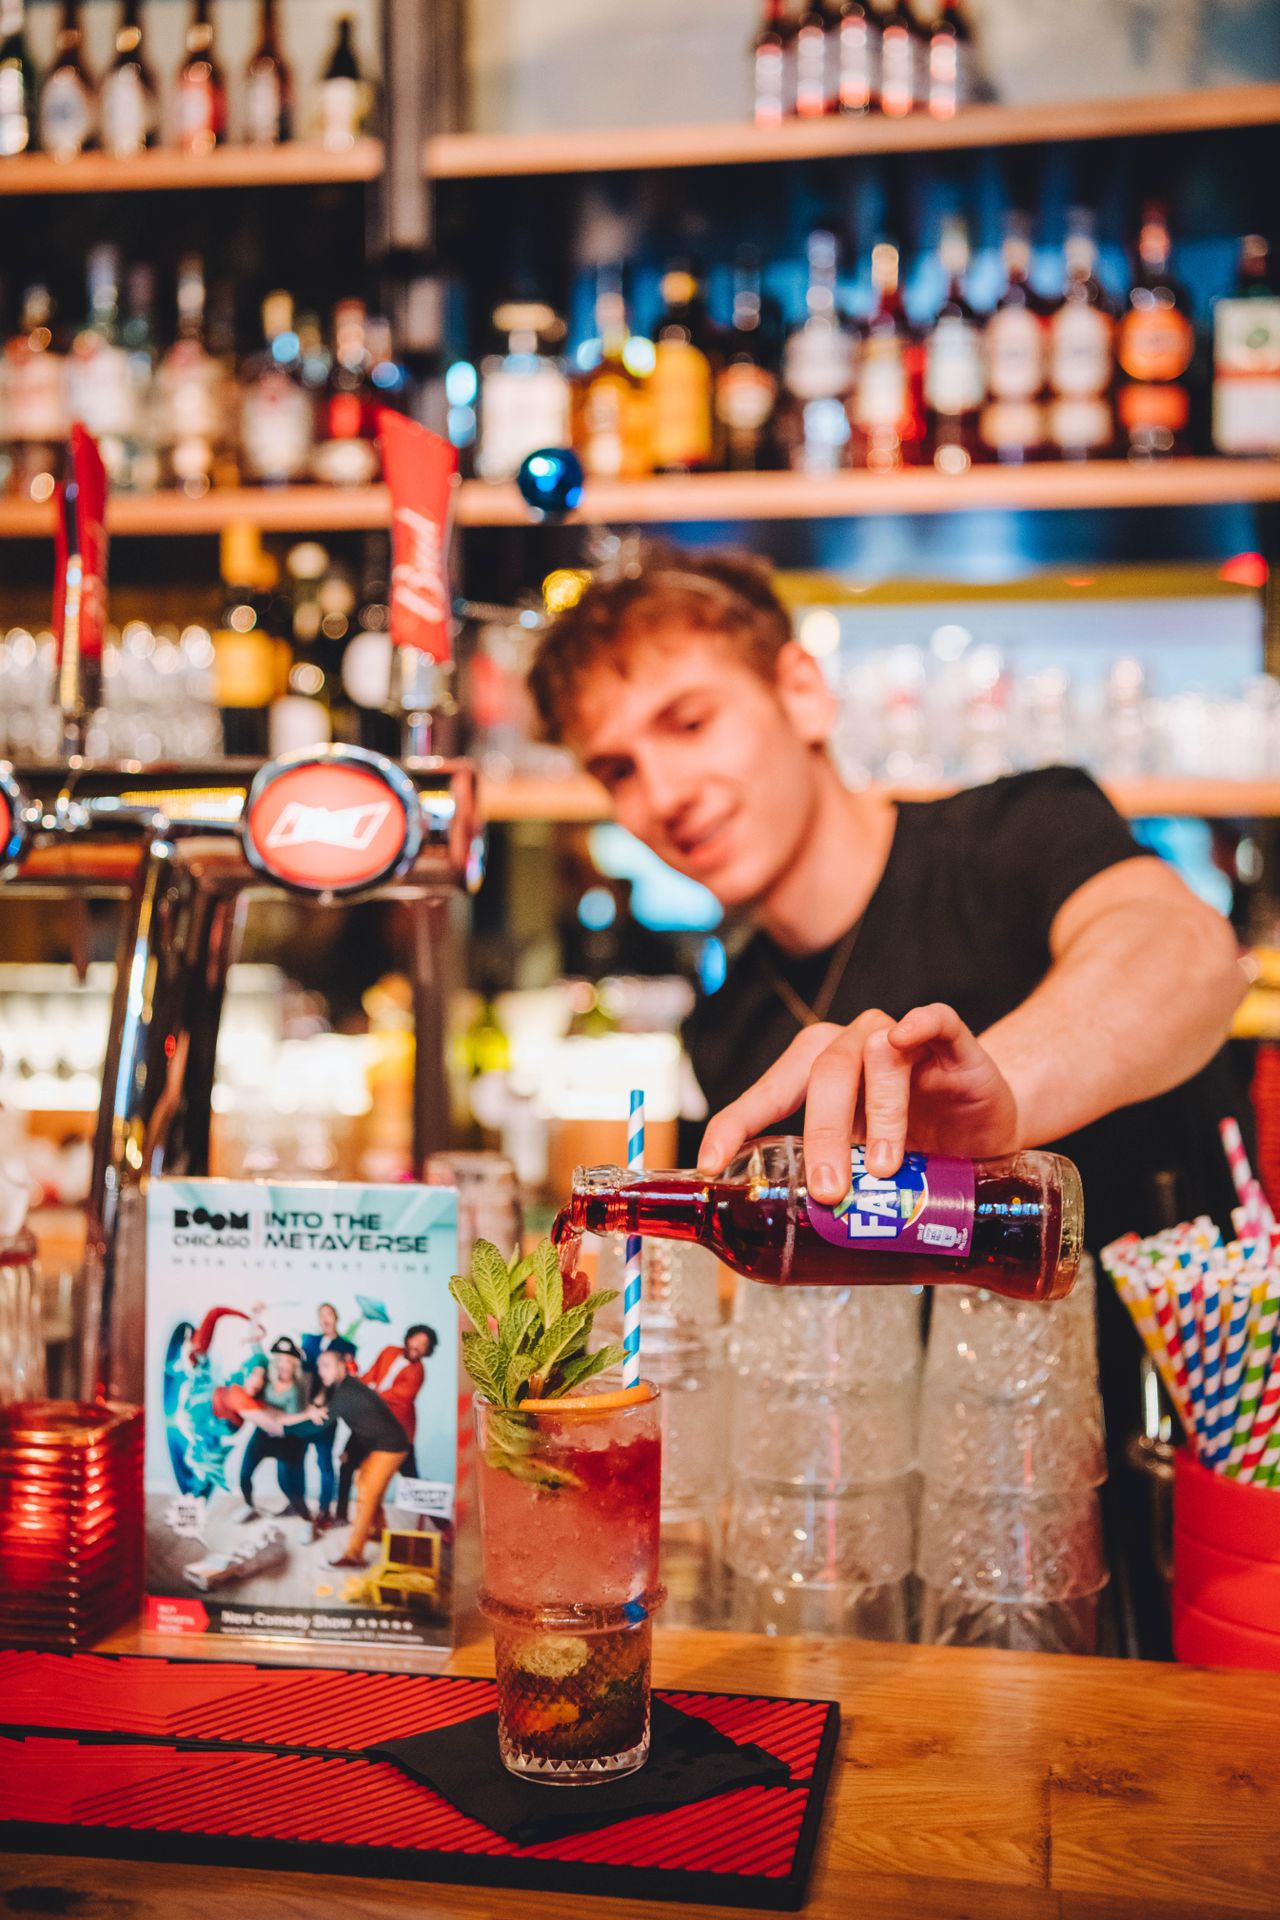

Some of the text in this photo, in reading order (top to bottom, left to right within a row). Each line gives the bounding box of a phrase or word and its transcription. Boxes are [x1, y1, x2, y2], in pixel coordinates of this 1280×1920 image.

[850, 1144, 898, 1237] FAN
[174, 1208, 249, 1231] BOOM
[264, 1212, 382, 1231] INTO THE
[173, 1235, 251, 1248] CHICAGO
[263, 1233, 430, 1253] METAVERSE
[220, 1610, 353, 1631] New Comedy Show
